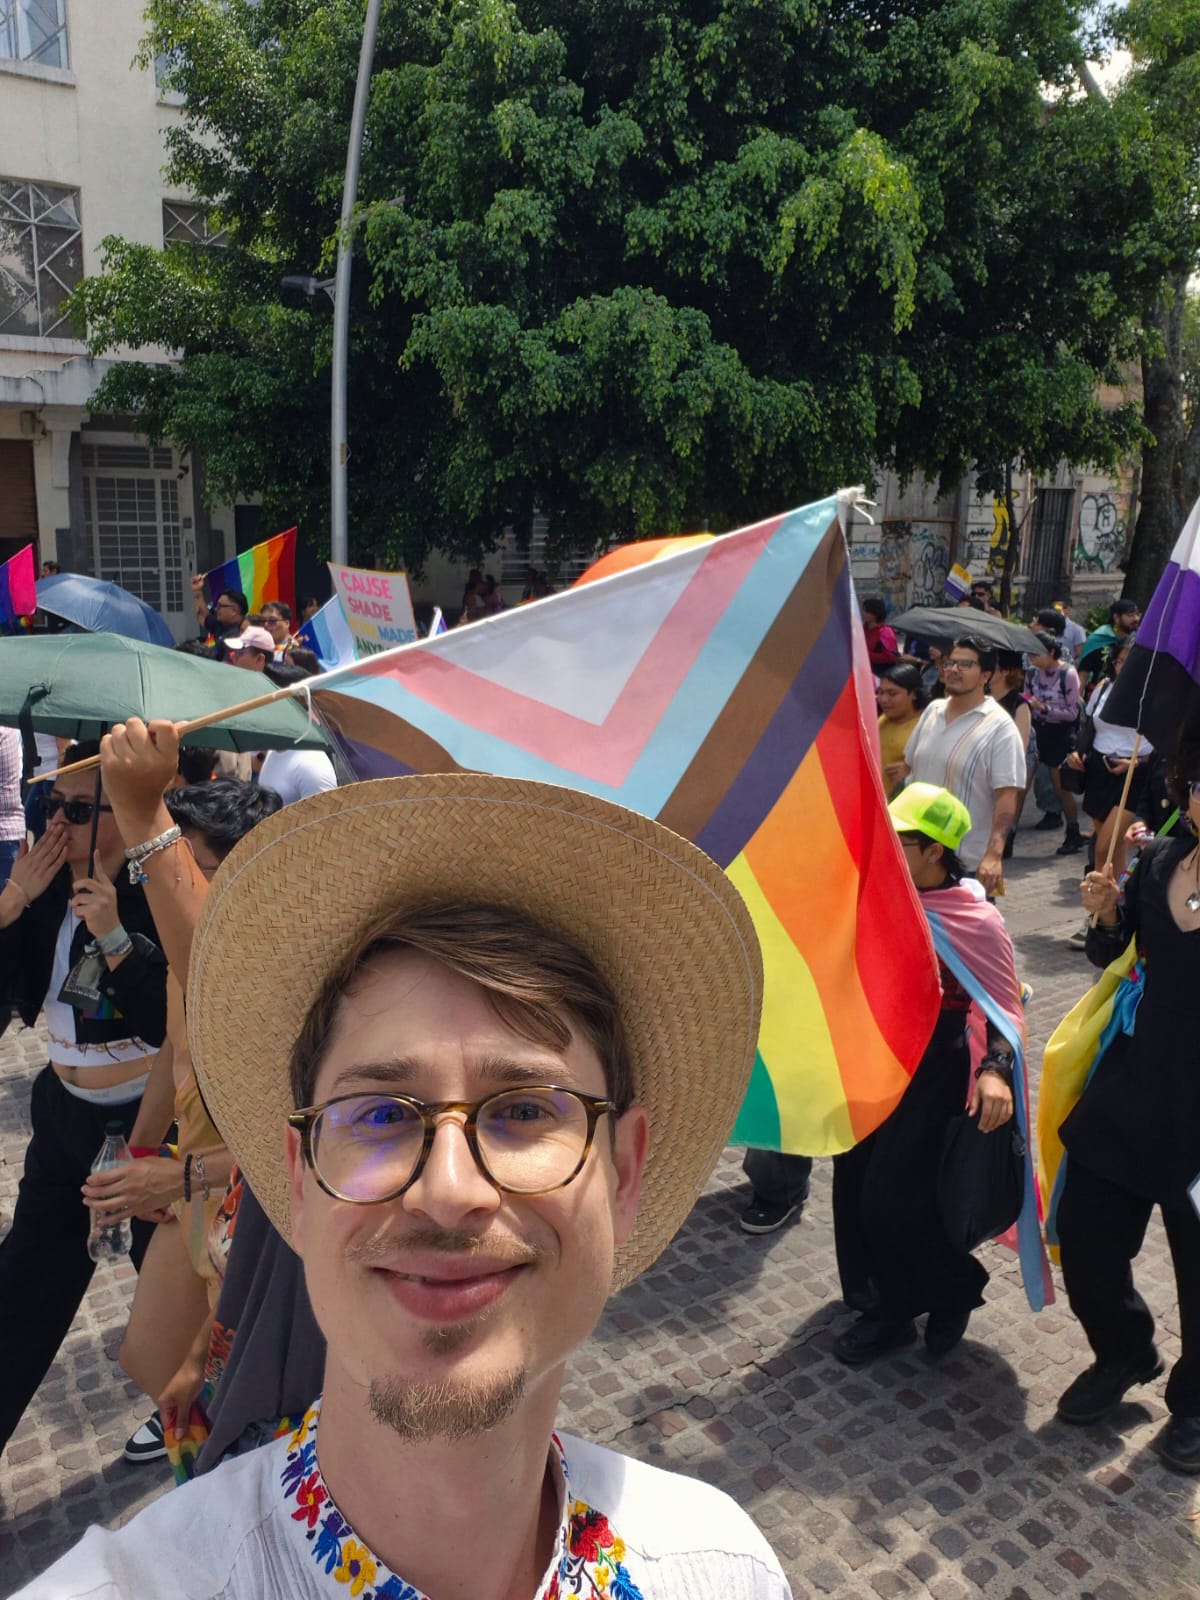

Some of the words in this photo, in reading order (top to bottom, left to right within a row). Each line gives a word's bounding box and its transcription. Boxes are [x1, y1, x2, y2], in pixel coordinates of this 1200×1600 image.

[341, 571, 393, 600] CAUSE
[348, 597, 393, 622] SHADE
[378, 626, 415, 642] MADE
